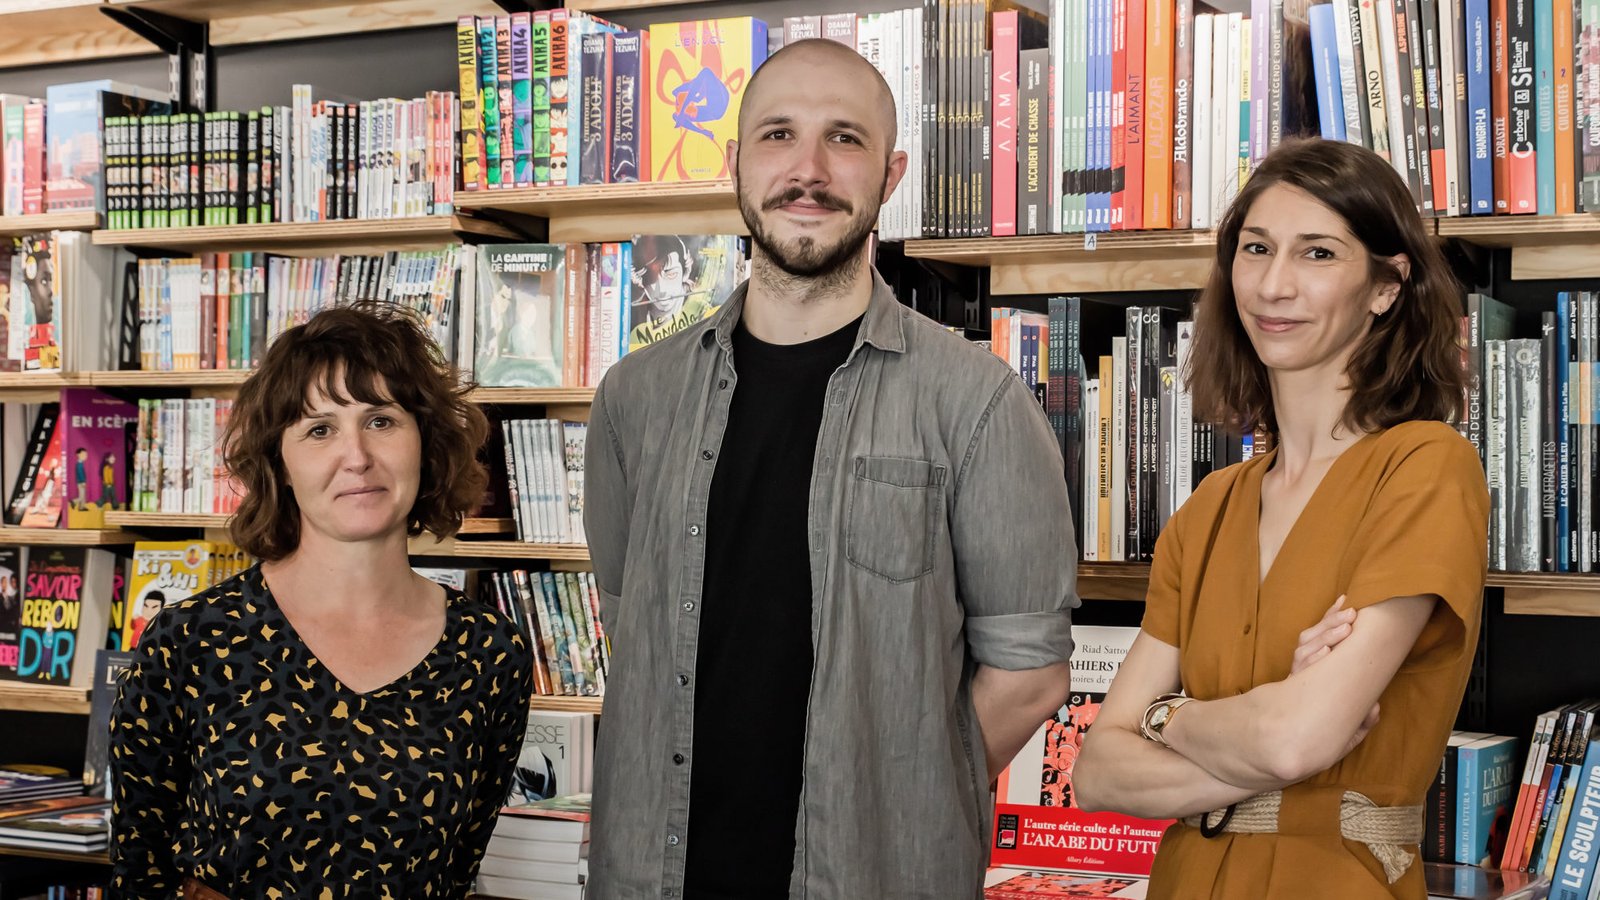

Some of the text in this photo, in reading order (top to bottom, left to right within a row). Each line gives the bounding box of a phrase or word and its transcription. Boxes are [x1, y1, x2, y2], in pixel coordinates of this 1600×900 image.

[791, 24, 814, 32] OSAMU
[1396, 13, 1407, 53] ASPIRINE
[460, 30, 474, 65] AKIRA
[1273, 29, 1281, 56] NOIRE
[1270, 59, 1280, 98] LÉGENDE
[1368, 70, 1382, 109] ARNO
[1414, 68, 1425, 109] ASPIRINE
[1428, 68, 1439, 109] ASPIRINE
[1028, 98, 1038, 129] CHASSE
[1128, 74, 1140, 144] L'AIMANT
[1174, 79, 1187, 162] Aldobrando
[1028, 132, 1038, 143] DE
[1476, 108, 1487, 159] SHANGRI-LA
[1028, 146, 1038, 192] L'ACCIDENT
[1088, 236, 1095, 247] A
[491, 253, 547, 263] LA CANTINE
[491, 263, 547, 272] DE MINUIT 6
[652, 316, 663, 330] Le
[72, 416, 92, 427] EN
[1143, 464, 1148, 472] LA
[1152, 464, 1156, 472] LA
[1561, 497, 1568, 507] LE
[138, 559, 160, 576] Ki
[26, 573, 82, 600] SAVOIR
[22, 599, 80, 630] REBON
[1082, 644, 1101, 654] Riad
[1070, 676, 1107, 684] toires de
[559, 745, 565, 759] 1
[1024, 819, 1057, 831] L'autre
[1058, 820, 1081, 832] série
[1083, 822, 1107, 833] culte
[1110, 824, 1121, 834] de
[1123, 824, 1162, 837] l'auteur
[1022, 832, 1087, 850] L'ARABE
[1089, 836, 1113, 851] DU
[1066, 855, 1105, 864] Allary Éditions
[1562, 864, 1585, 888] LE
